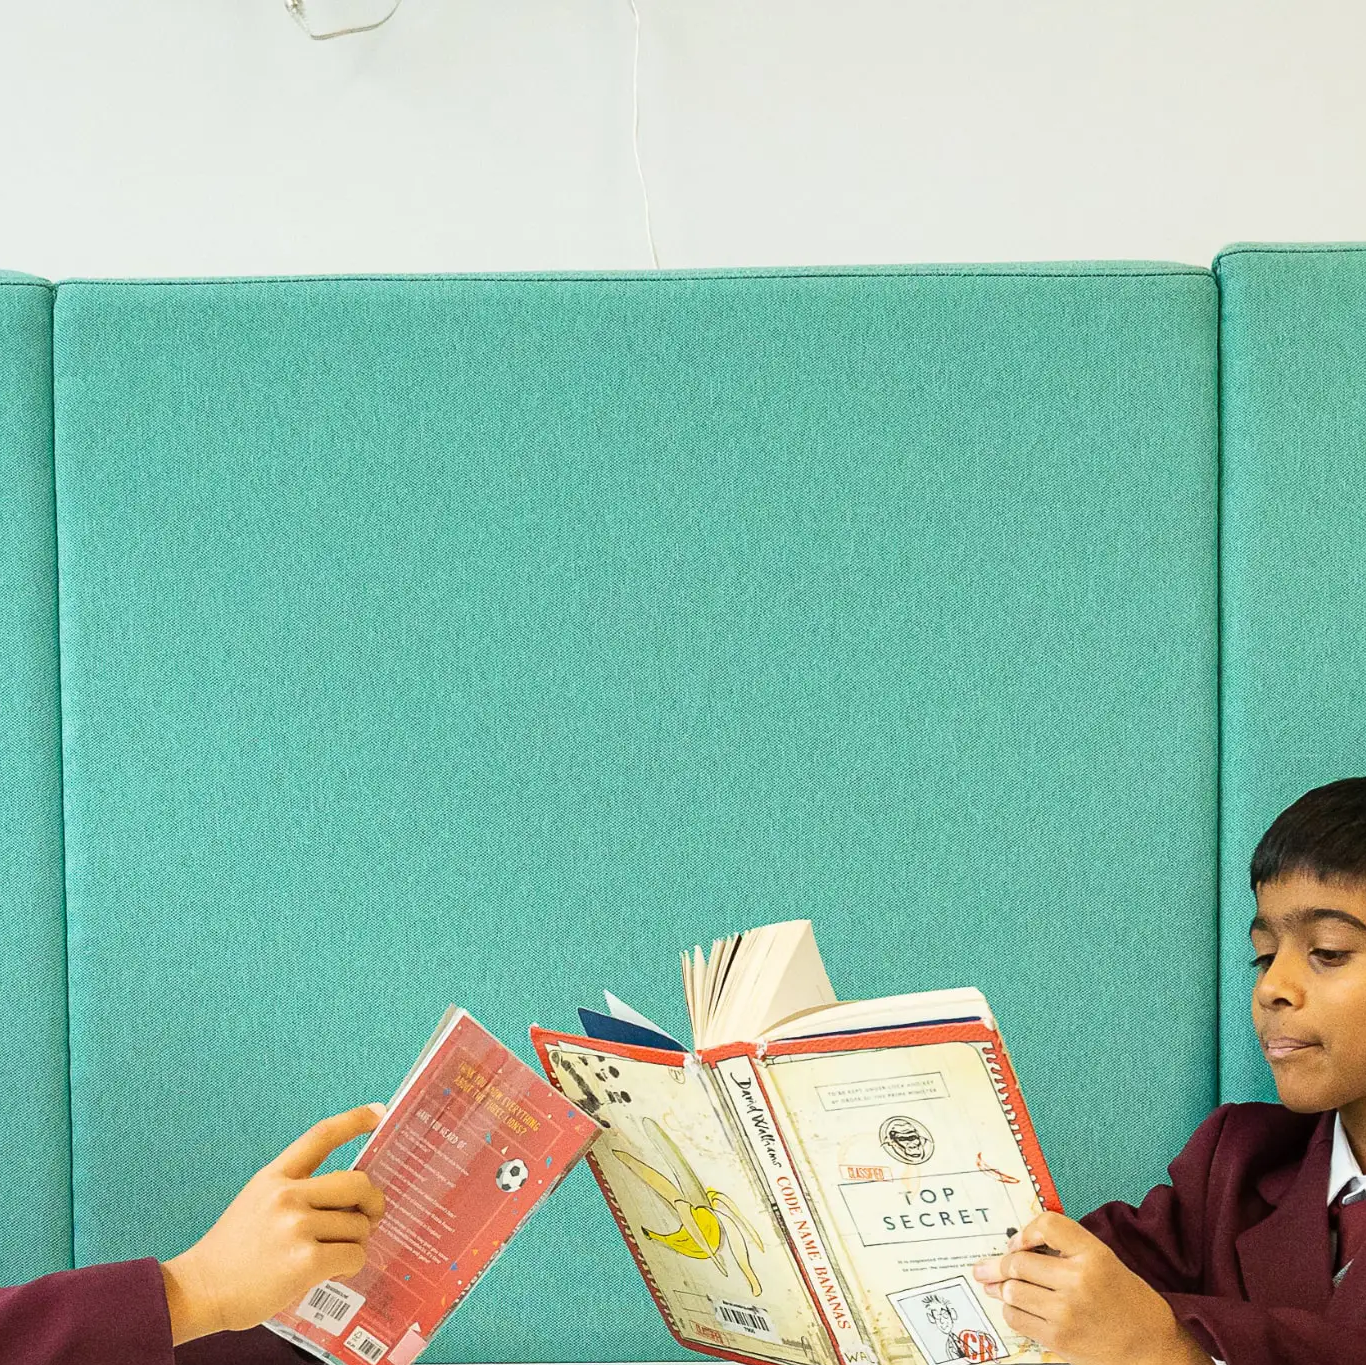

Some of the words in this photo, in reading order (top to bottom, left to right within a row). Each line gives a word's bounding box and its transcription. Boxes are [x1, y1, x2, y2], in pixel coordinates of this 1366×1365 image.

[416, 1109, 432, 1124] HAVE
[430, 1119, 443, 1132] YOU
[439, 1126, 459, 1144] HEARD
[472, 1089, 486, 1104] THE
[484, 1100, 505, 1120] THREE
[502, 1115, 528, 1136] LIONS?
[501, 1096, 541, 1132] EVERYTHING
[730, 1072, 763, 1114] David
[752, 1113, 782, 1168] Walliams
[847, 1167, 885, 1180] CLASSIFIED
[899, 1187, 954, 1206] TOP
[883, 1208, 989, 1230] SECRET
[776, 1176, 803, 1215] CODE
[794, 1220, 823, 1261] NAME
[814, 1266, 852, 1330] BANANAS
[844, 1351, 877, 1364] WAL
